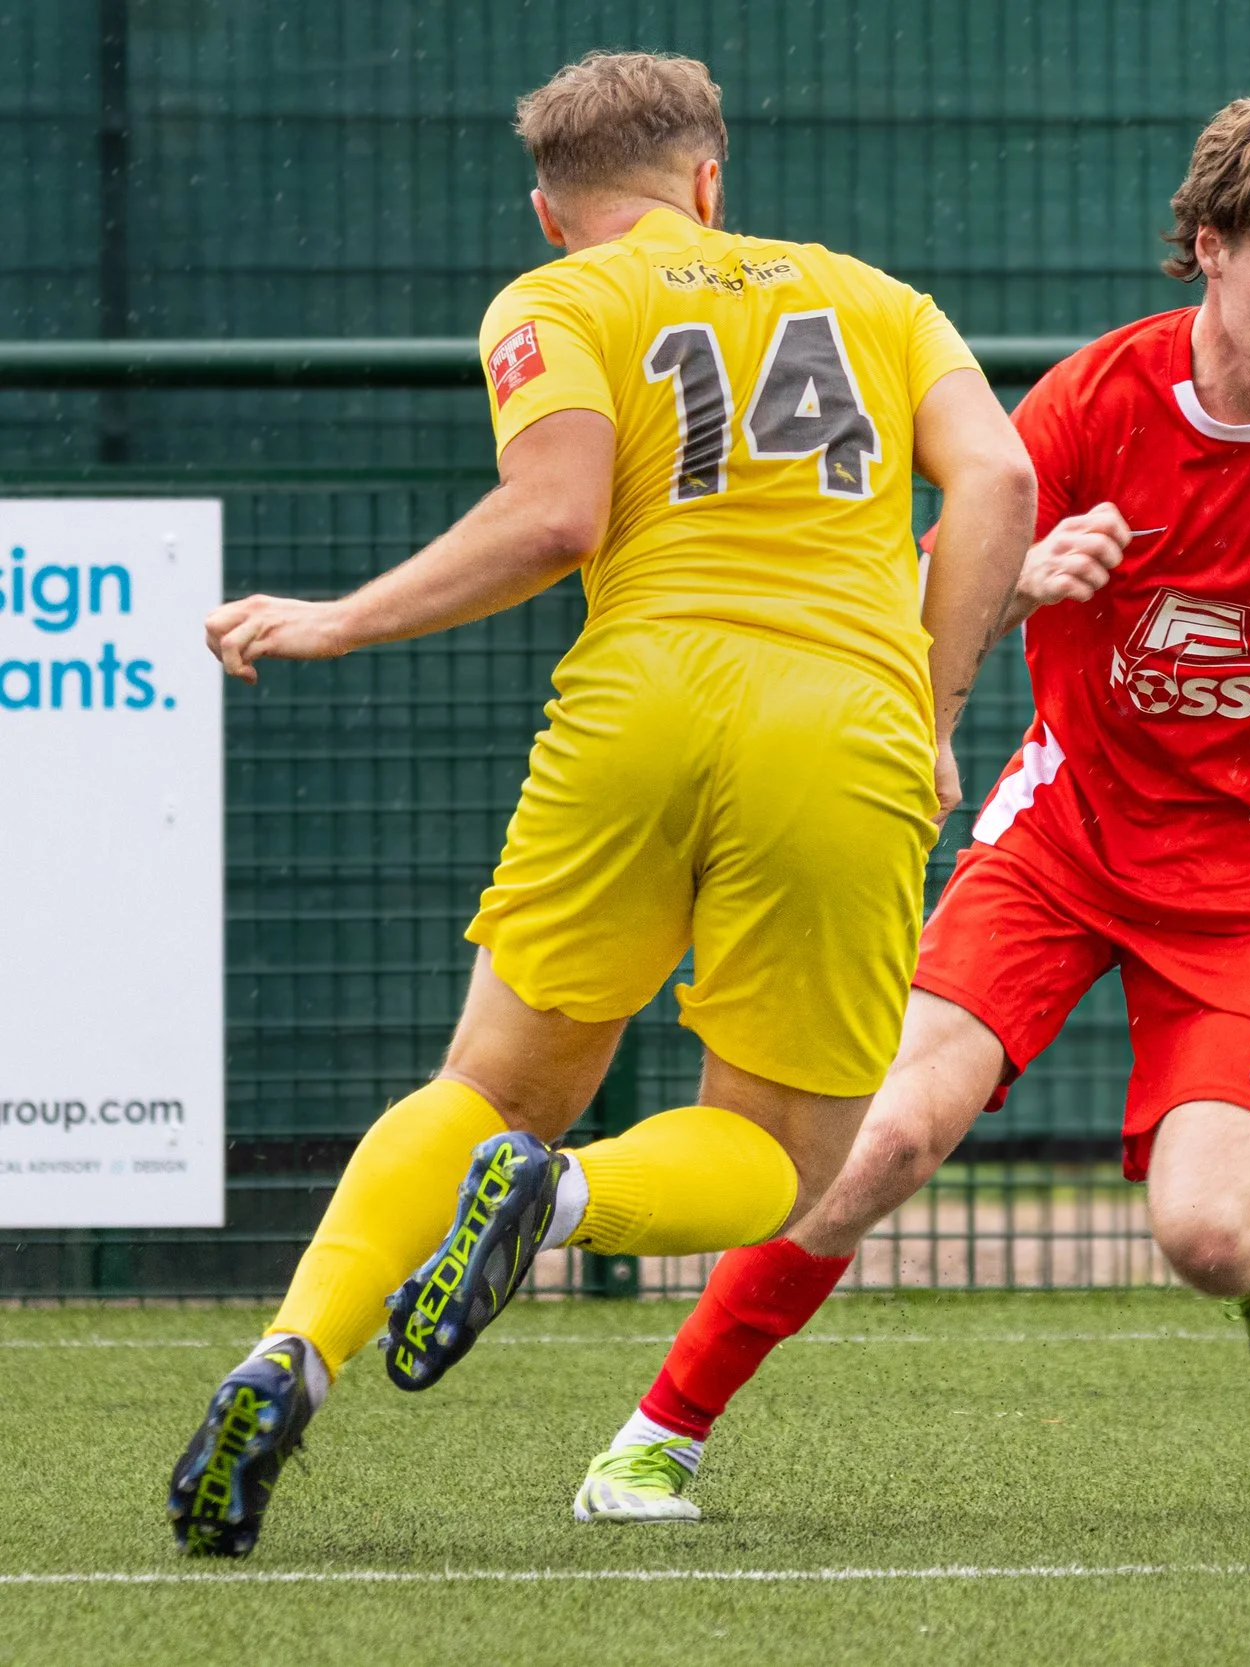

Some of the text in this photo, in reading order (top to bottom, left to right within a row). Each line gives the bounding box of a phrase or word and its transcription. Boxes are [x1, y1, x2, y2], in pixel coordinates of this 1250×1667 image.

[666, 269, 696, 285] AJ
[643, 308, 882, 505] 14
[0, 546, 132, 634] ign
[0, 642, 176, 710] ants.
[28, 1160, 101, 1174] ADVISORY
[132, 1159, 188, 1174] DESIGN
[395, 1142, 528, 1377] PREDATOR
